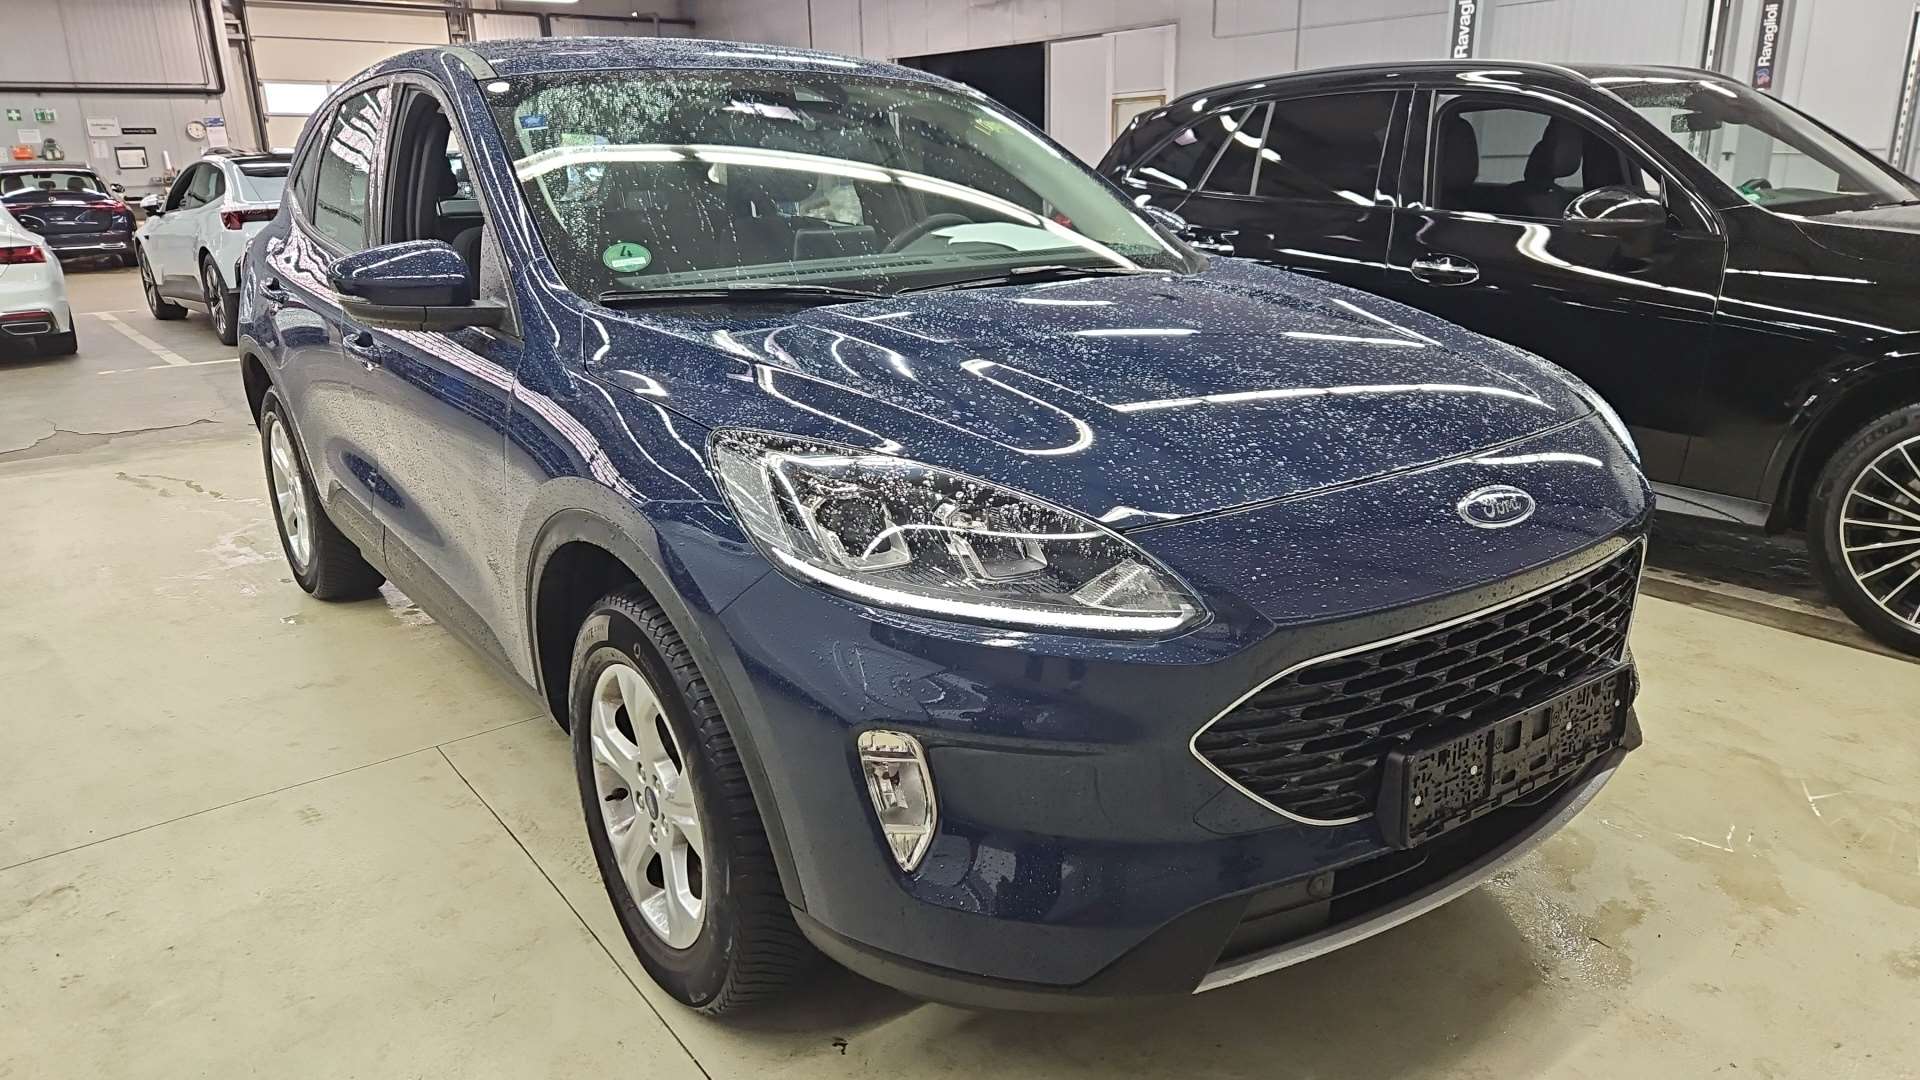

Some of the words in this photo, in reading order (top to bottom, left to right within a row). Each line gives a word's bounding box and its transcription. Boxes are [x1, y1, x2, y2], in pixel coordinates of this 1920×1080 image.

[1757, 3, 1779, 67] Ravaglioli
[620, 245, 633, 257] 4
[1479, 494, 1522, 518] Ford
